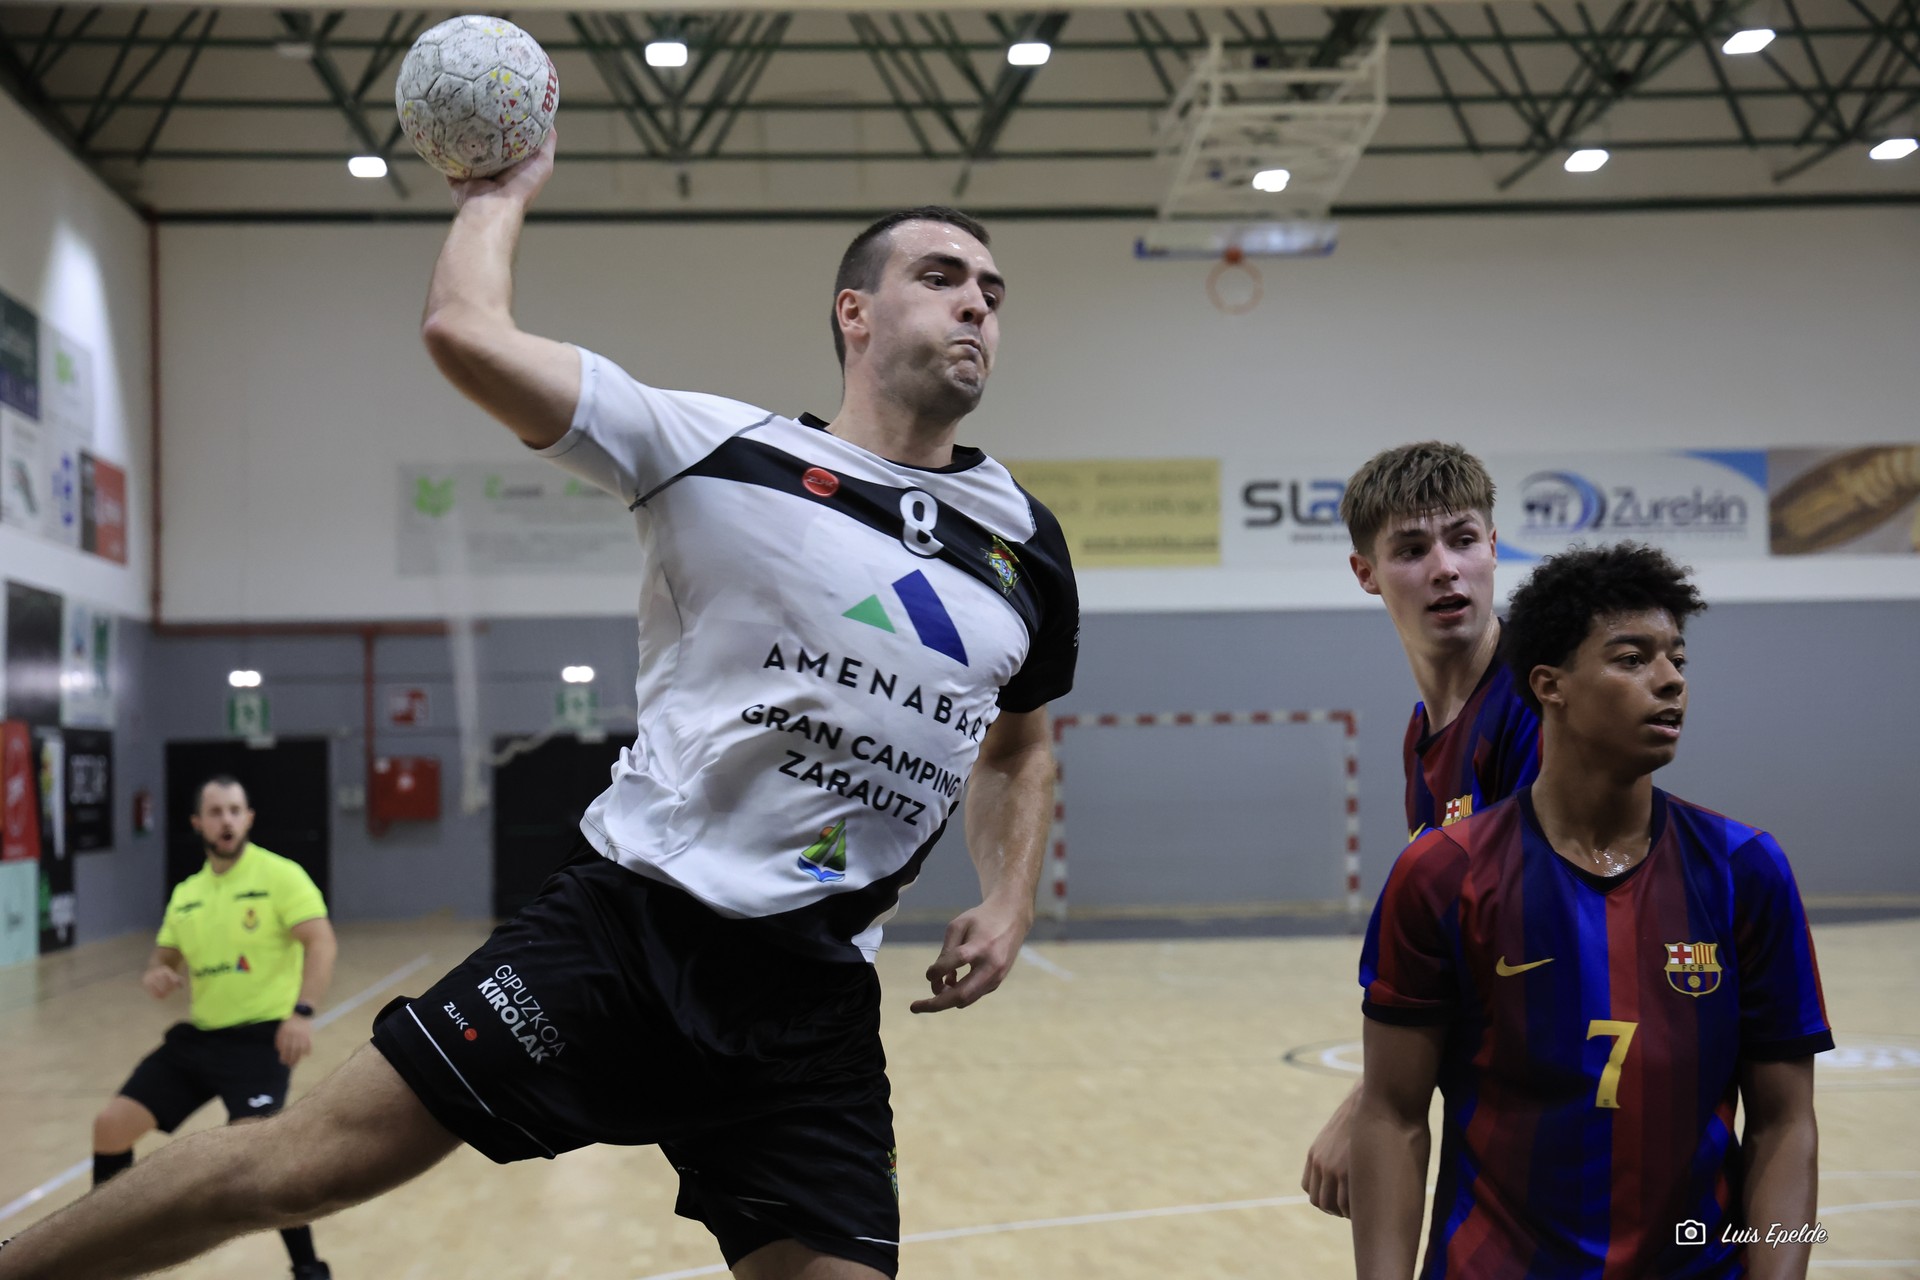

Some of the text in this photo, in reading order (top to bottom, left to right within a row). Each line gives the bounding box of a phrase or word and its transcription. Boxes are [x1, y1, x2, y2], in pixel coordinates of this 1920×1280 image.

[900, 488, 944, 557] 8
[763, 642, 983, 743] AMENABAR
[741, 703, 961, 799] GRAN CAMPING
[778, 749, 926, 826] ZARAUTZ
[477, 977, 550, 1065] KIROLAK
[494, 964, 567, 1057] GIPUZKOA
[1586, 1019, 1639, 1109] 7
